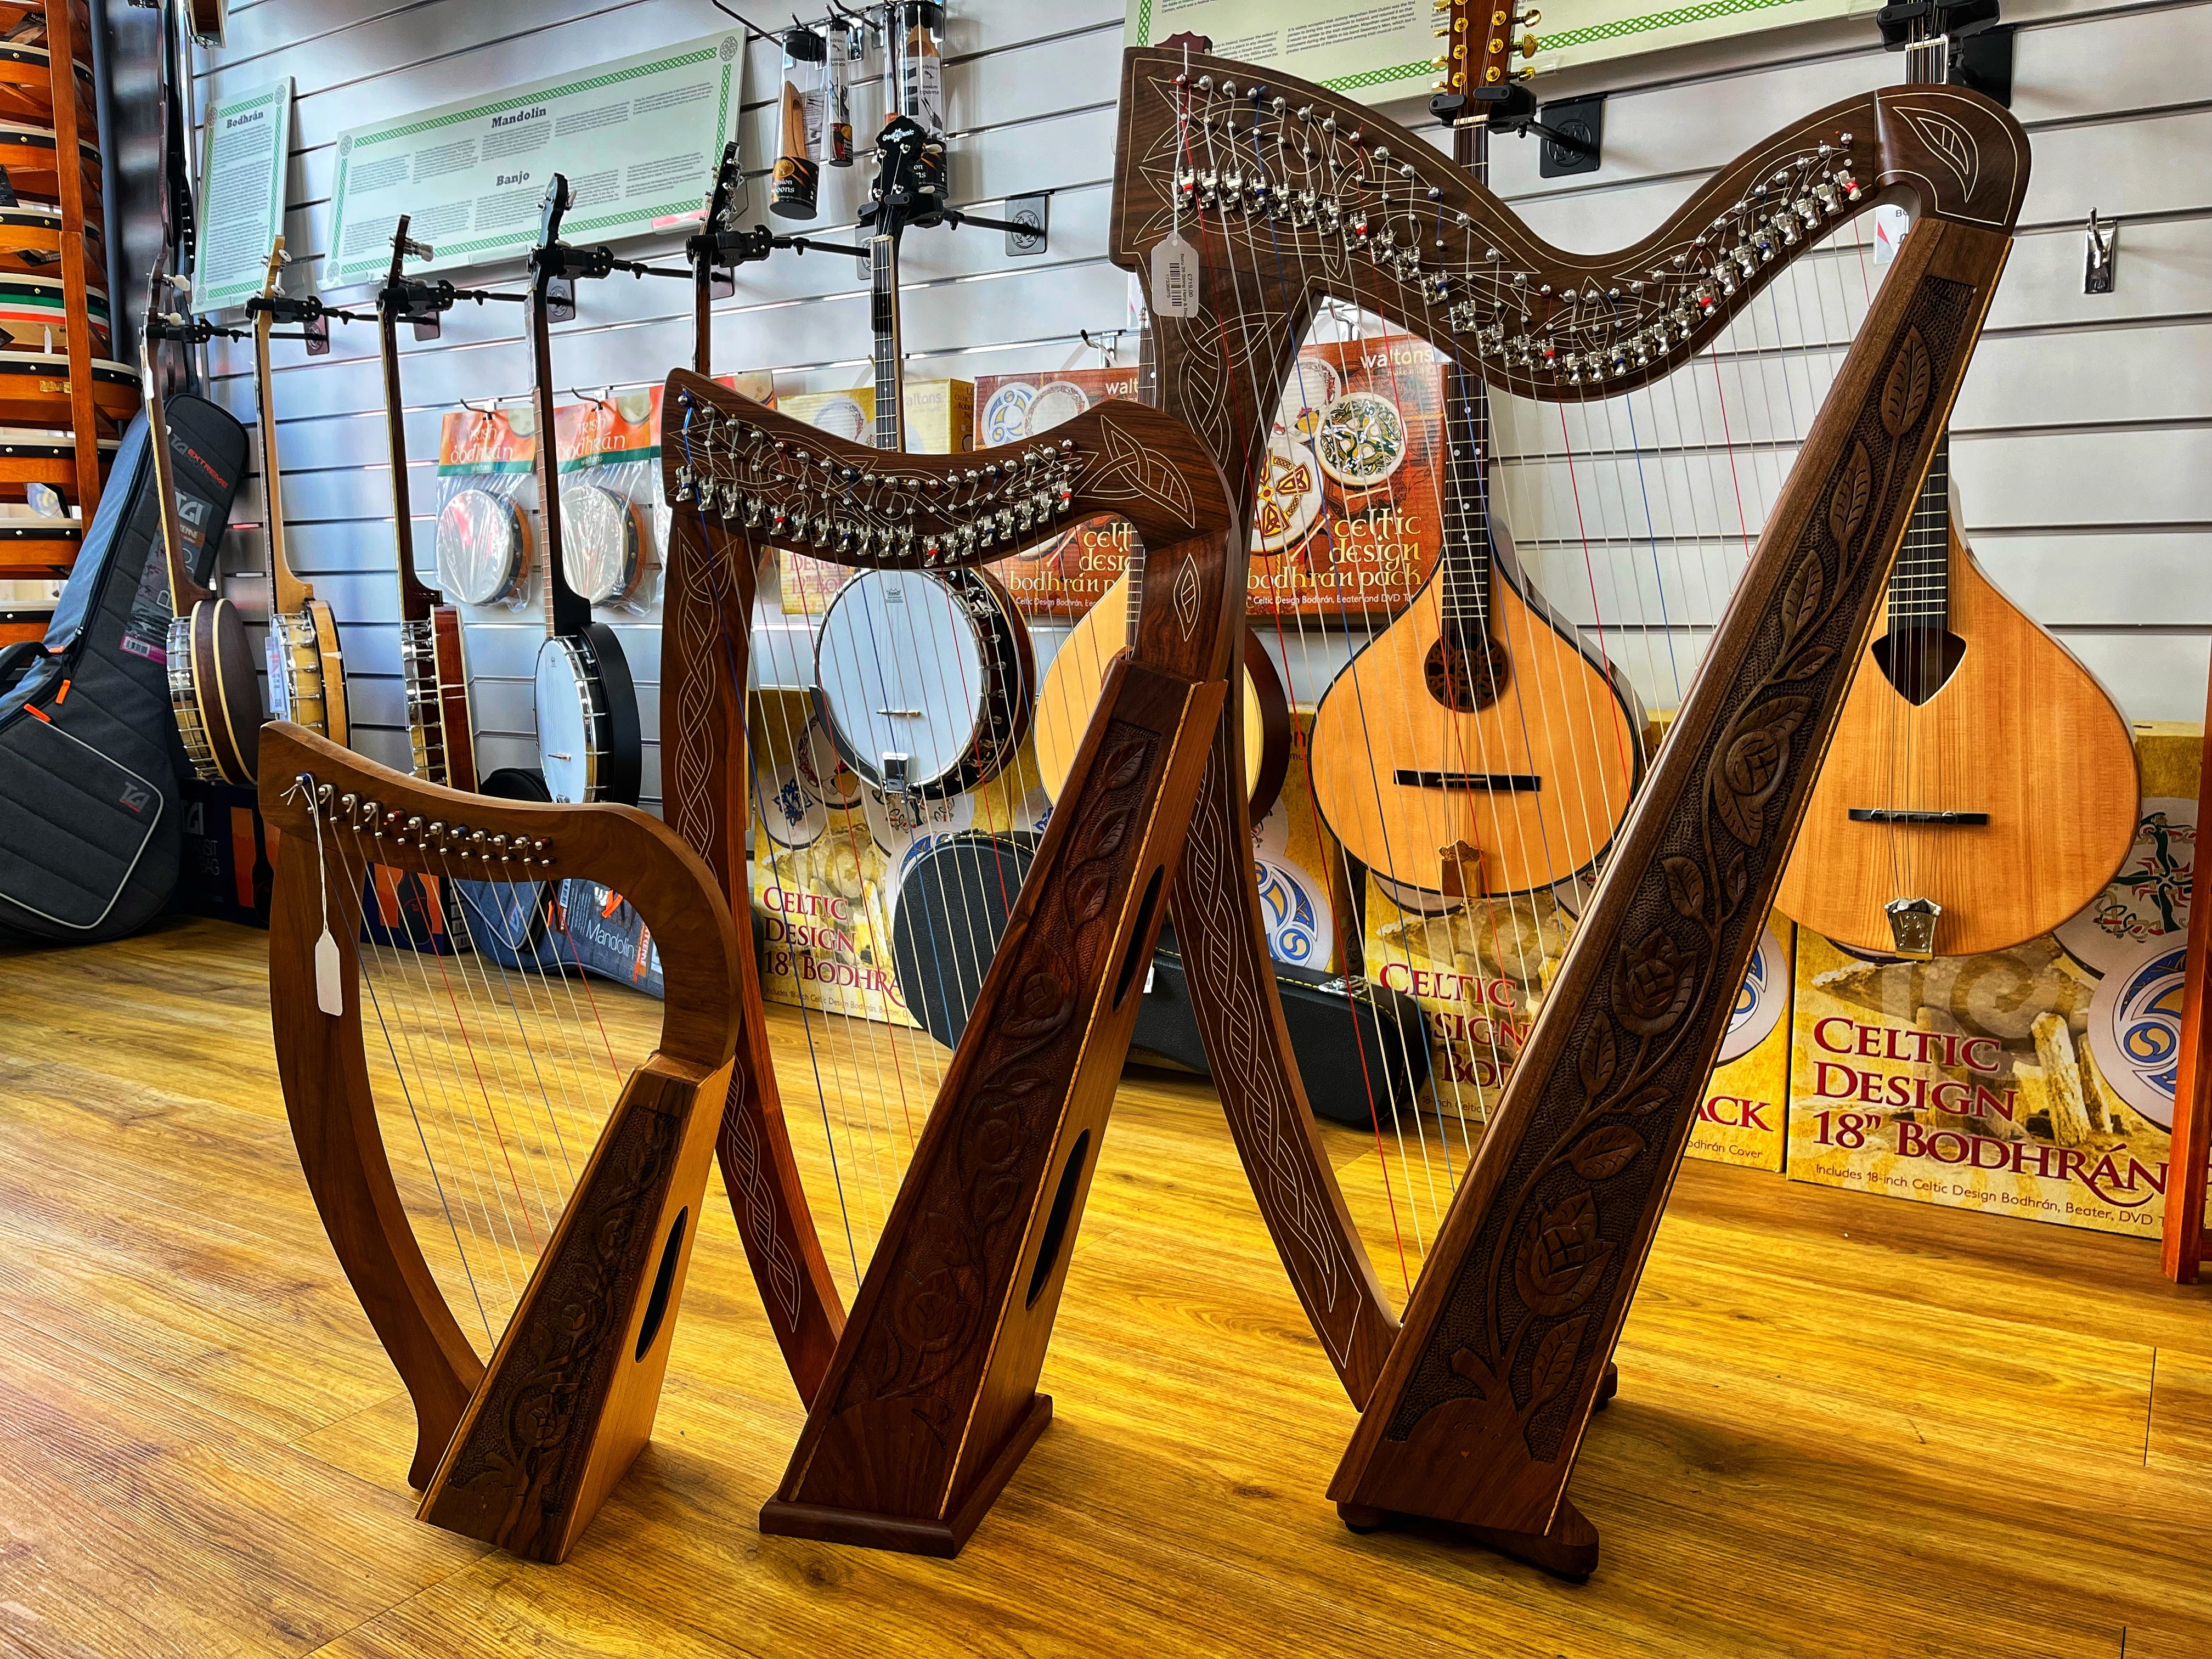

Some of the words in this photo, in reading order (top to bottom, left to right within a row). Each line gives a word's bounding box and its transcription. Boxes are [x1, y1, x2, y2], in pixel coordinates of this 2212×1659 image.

[227, 110, 263, 128] Bodhrán
[492, 107, 546, 128] Mandolin
[496, 171, 530, 186] Banjo
[1359, 348, 1432, 369] waltons
[906, 392, 941, 407] altons
[1105, 377, 1139, 395] walt
[188, 448, 229, 489] EXTREME
[581, 455, 603, 466] waltons
[175, 492, 204, 526] TGI
[1334, 507, 1421, 540] celtic
[1083, 522, 1132, 551] celt
[1329, 534, 1421, 572] design
[1079, 548, 1131, 571] desi
[1009, 571, 1100, 593] bodhrán
[1247, 566, 1355, 589] bodhrán
[1359, 562, 1423, 595] pack
[1253, 595, 1273, 605] Celtic
[1276, 595, 1300, 606] Design
[1381, 592, 1400, 602] DVD
[763, 885, 849, 921] CELTIC
[585, 919, 635, 961] Mandolin
[763, 916, 856, 953] DESIGN
[1379, 963, 1516, 1007] CELTIC
[1424, 1011, 1531, 1047] SIGN
[1813, 1017, 2000, 1071] CELTIC
[1813, 1061, 2018, 1121] DESIGN
[1699, 1096, 1774, 1132] CK
[1688, 1139, 1725, 1153] odhrán
[1729, 1144, 1764, 1159] Cover
[1894, 1119, 2170, 1207] BODHRÁN
[1816, 1163, 1863, 1180] Includes
[1866, 1171, 1908, 1187] 18-inch
[1912, 1178, 1948, 1194] Celtic
[1953, 1184, 1997, 1203] Design
[2001, 1192, 2061, 1214] Bodhrán,
[2066, 1202, 2114, 1222] Beater,
[2119, 1210, 2153, 1226] DVD
